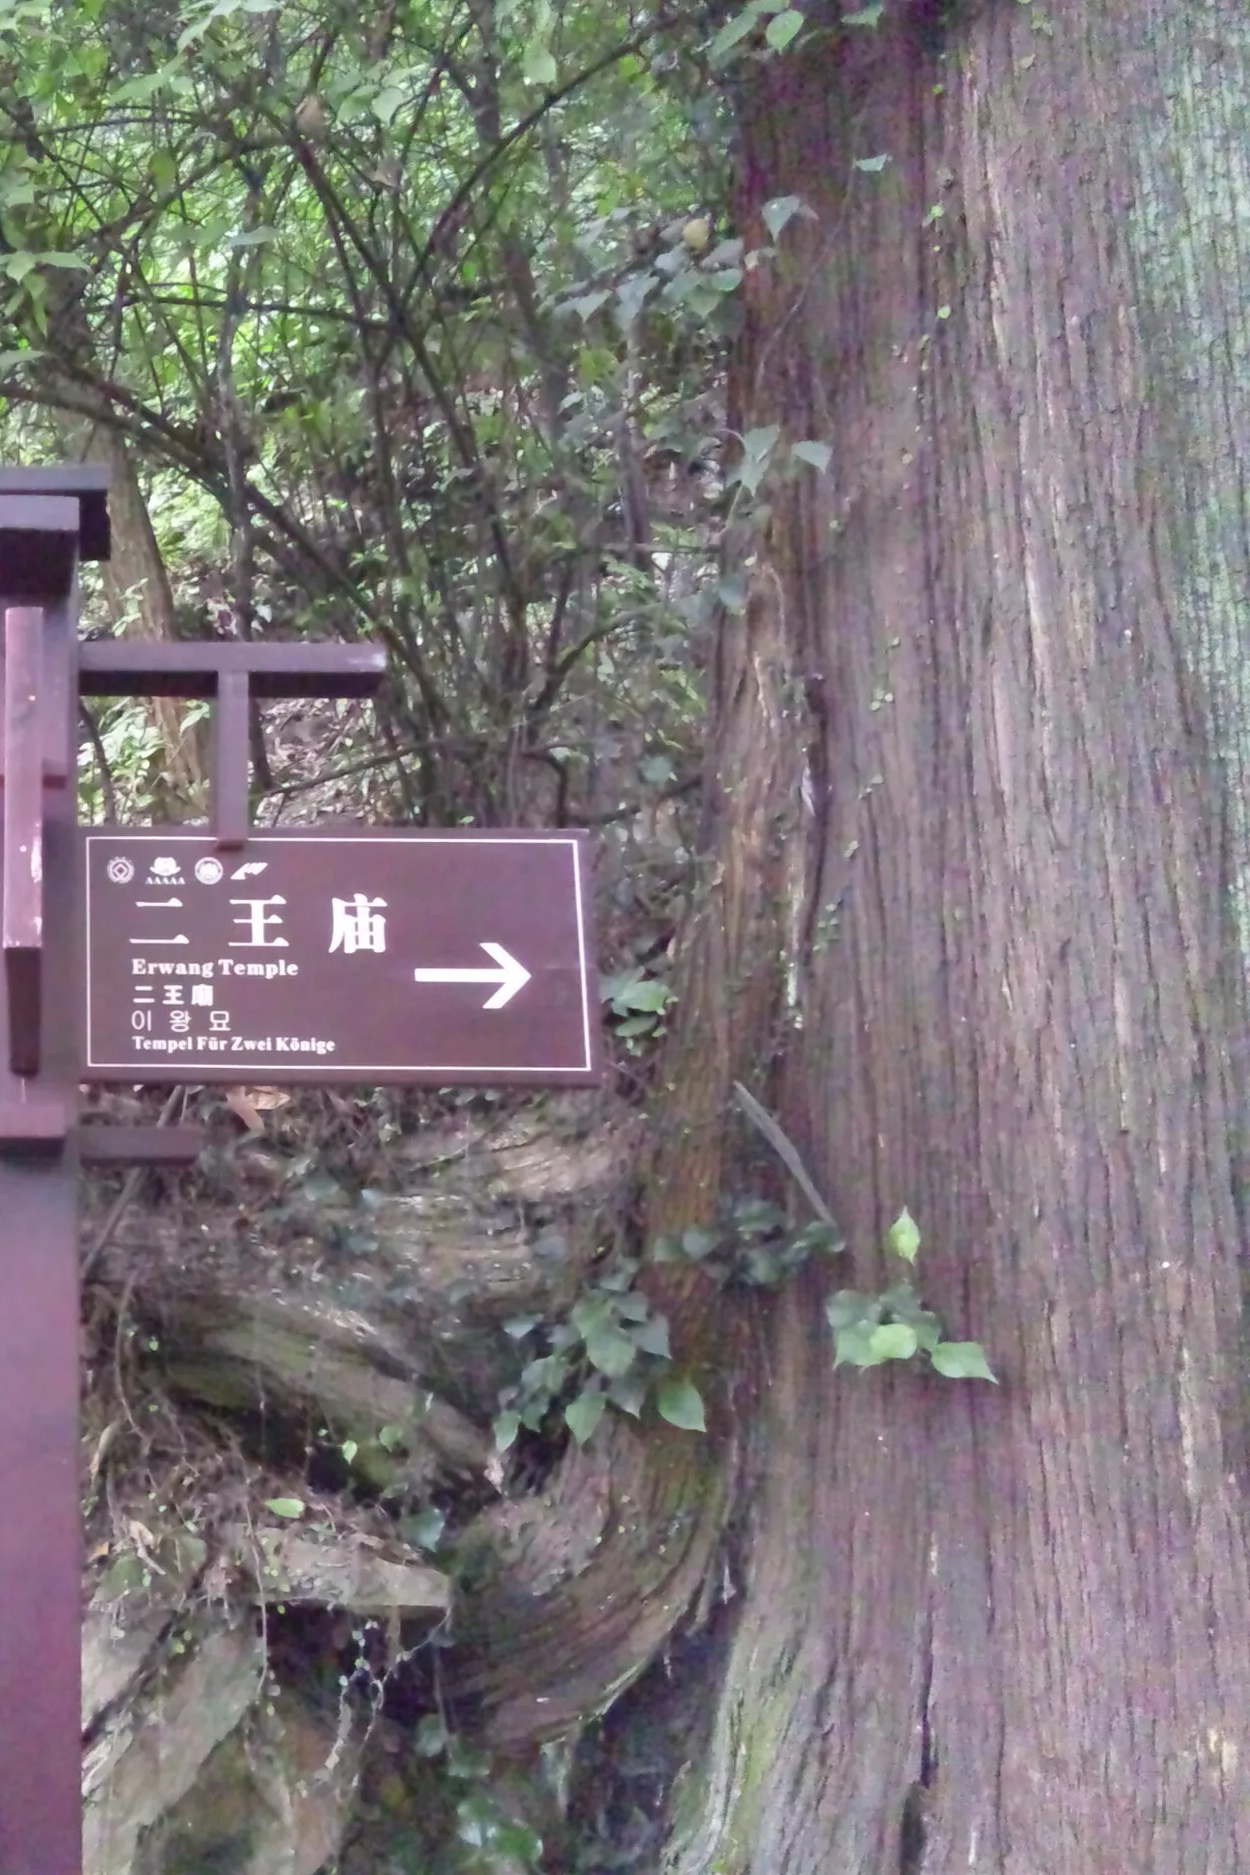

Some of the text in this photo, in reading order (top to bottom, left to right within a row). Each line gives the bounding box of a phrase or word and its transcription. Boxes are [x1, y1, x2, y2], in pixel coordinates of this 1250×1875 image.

[129, 893, 388, 954] 二王庙
[131, 958, 299, 979] Erwang Temple
[132, 1036, 336, 1055] Tempel Für Zwei Könige
